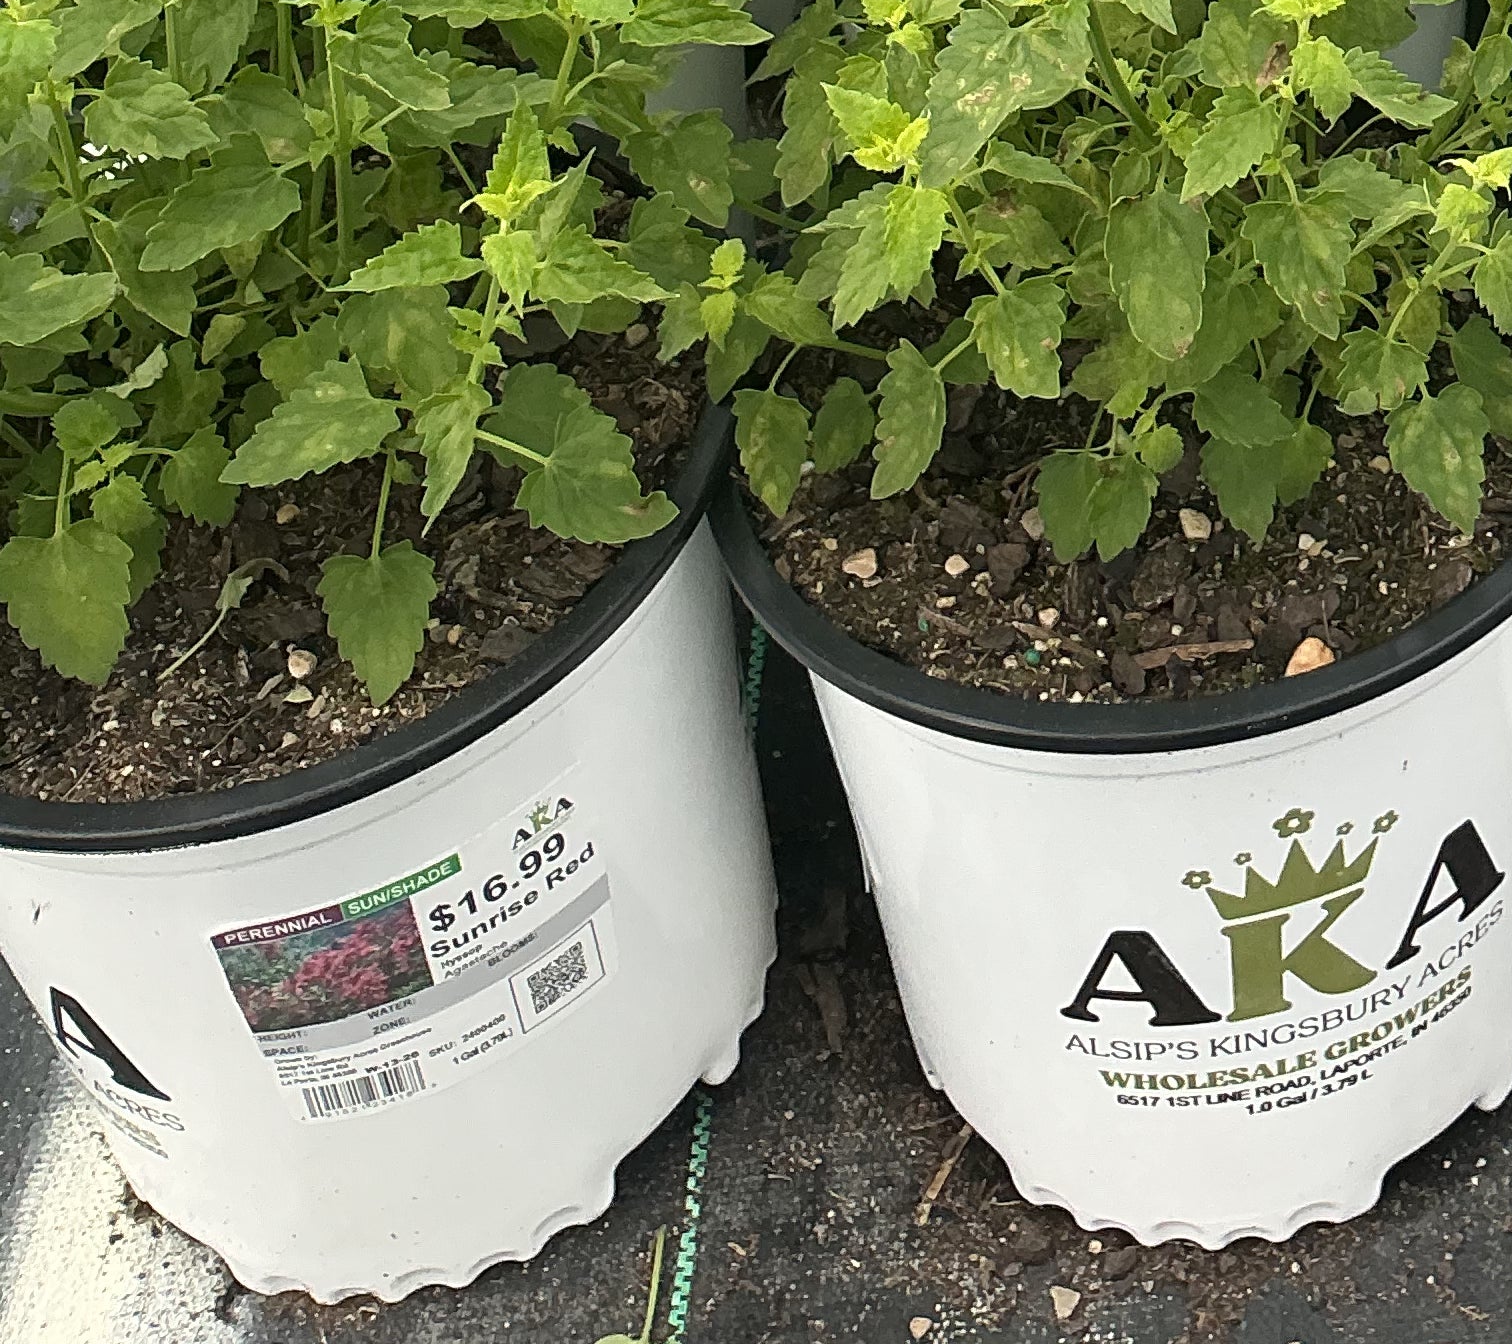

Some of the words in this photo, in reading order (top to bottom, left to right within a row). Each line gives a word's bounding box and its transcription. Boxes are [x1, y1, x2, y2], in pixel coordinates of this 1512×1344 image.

[512, 797, 575, 850] AKA
[223, 911, 333, 946] PERENNIAL
[347, 861, 453, 915] SUN/SHADE
[429, 832, 566, 932] $16.99
[430, 890, 539, 958] Sunrise
[545, 841, 595, 891] Red
[1060, 818, 1506, 1027] AKA
[1064, 1034, 1200, 1061] ALSIP'S
[1210, 974, 1412, 1058] KINGSBURY
[1417, 899, 1504, 988] ACRES
[372, 1016, 411, 1035] ZONE:
[428, 1041, 457, 1058] SKU:
[1098, 1049, 1318, 1091] WHOLESALE
[1323, 964, 1472, 1061] GROWERS
[1116, 1094, 1160, 1107] 6517
[1166, 1094, 1202, 1107] 1ST
[1205, 1089, 1251, 1105] LINE
[1411, 1019, 1428, 1038] IN
[1244, 1096, 1272, 1115] 1.0
[1276, 1090, 1307, 1109] Gal
[1361, 1068, 1374, 1080] L
